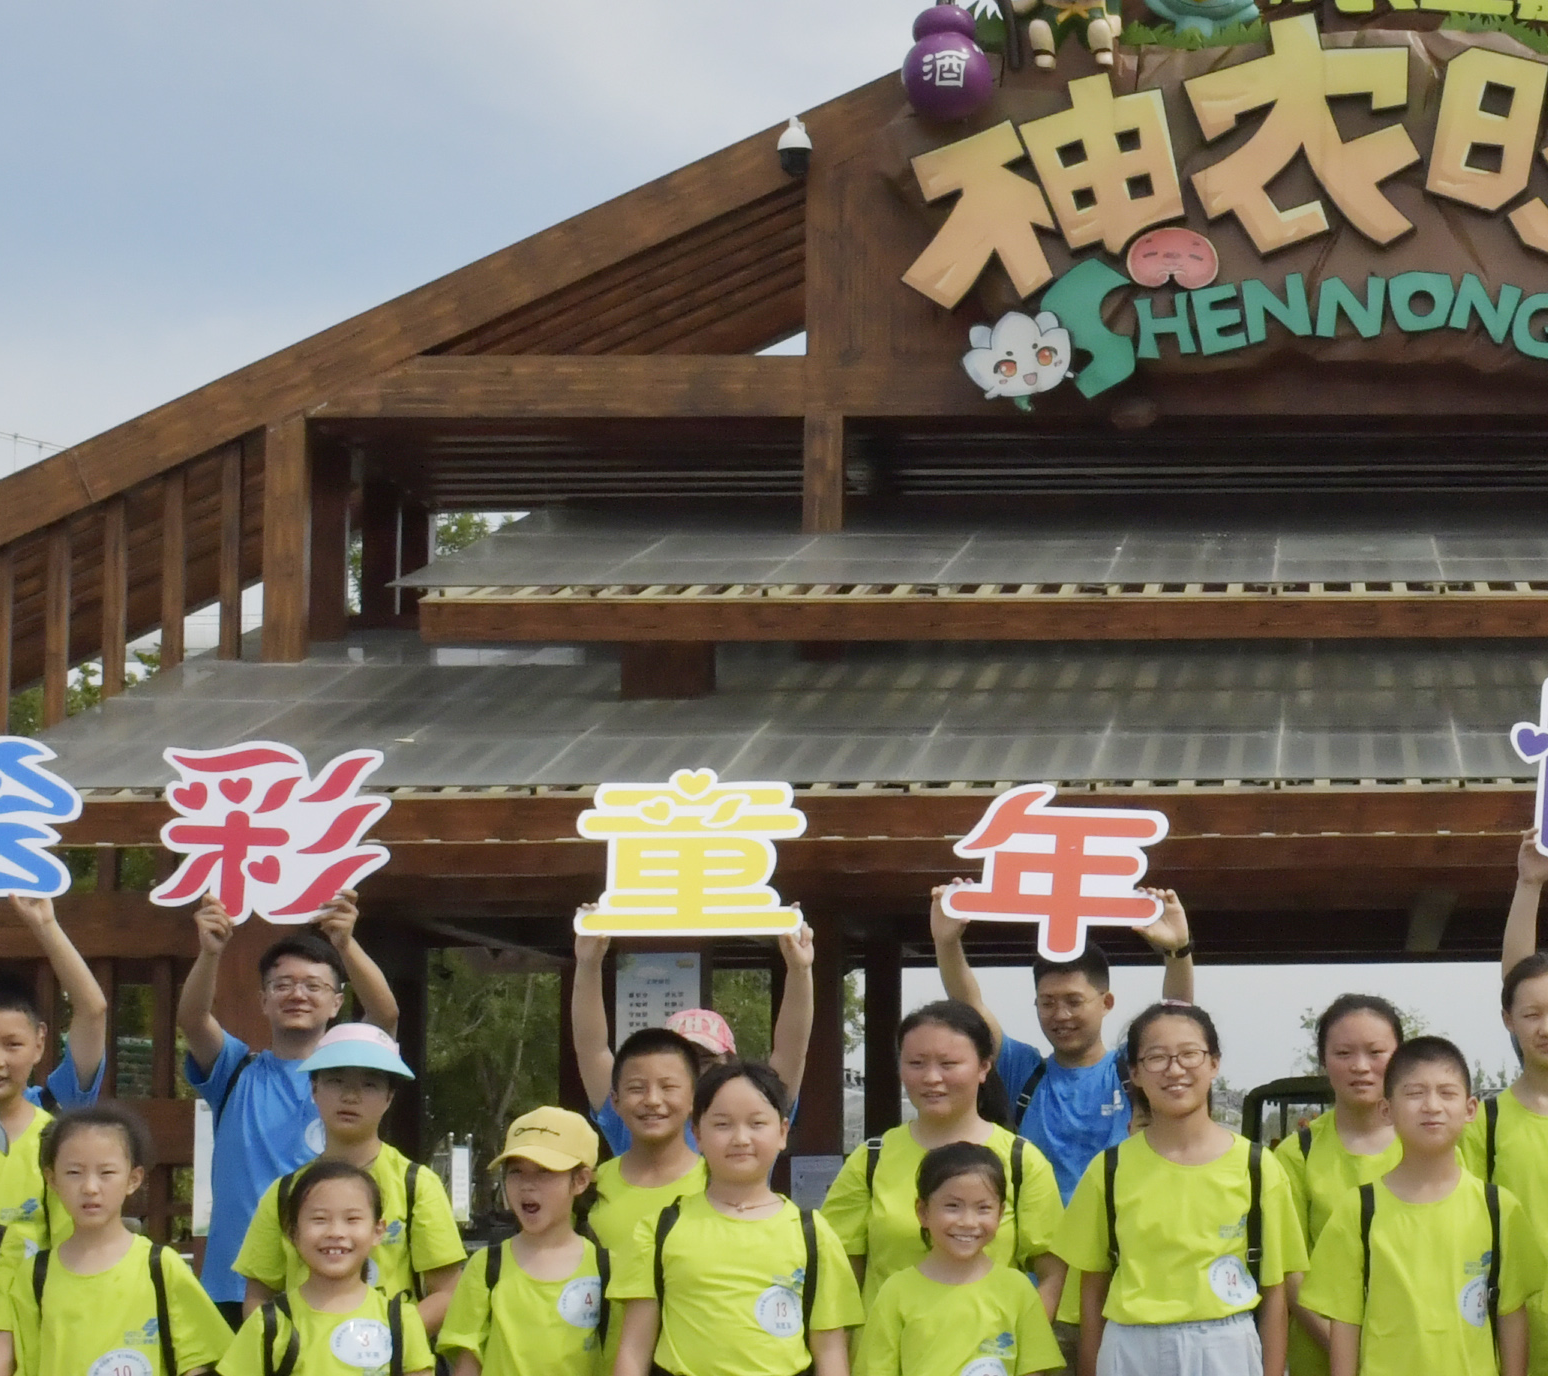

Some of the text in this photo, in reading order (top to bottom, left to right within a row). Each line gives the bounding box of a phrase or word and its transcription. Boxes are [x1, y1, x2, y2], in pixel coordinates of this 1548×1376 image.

[922, 50, 970, 88] 酒
[152, 742, 388, 922] 彩
[576, 771, 805, 933] 童
[943, 786, 1167, 960] 年
[585, 1293, 593, 1307] 4
[776, 1302, 788, 1318] 13
